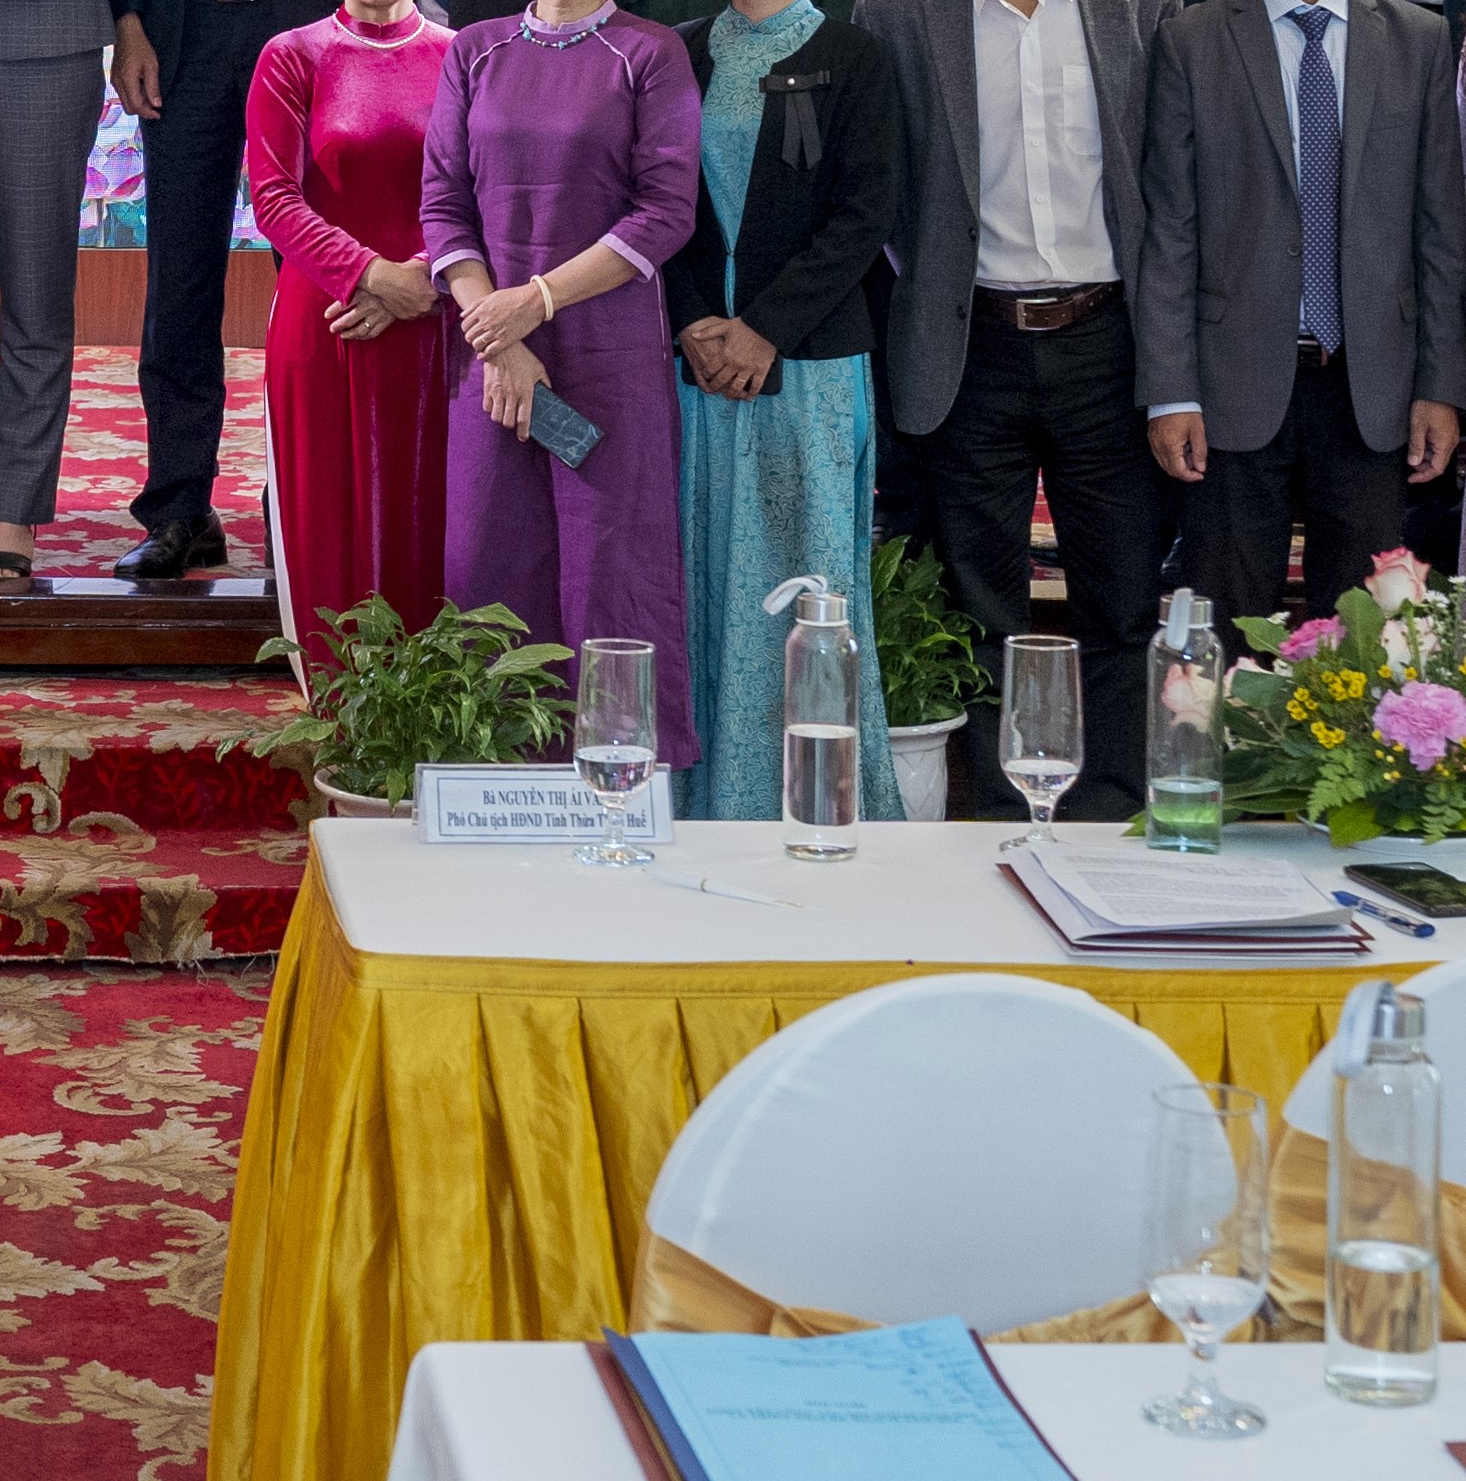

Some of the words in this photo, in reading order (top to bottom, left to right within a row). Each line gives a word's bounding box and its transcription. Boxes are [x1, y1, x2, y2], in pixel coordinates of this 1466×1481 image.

[446, 812, 466, 827] Phó
[490, 813, 508, 830] tịch
[510, 812, 543, 827] HĐND
[627, 809, 647, 827] Huế
